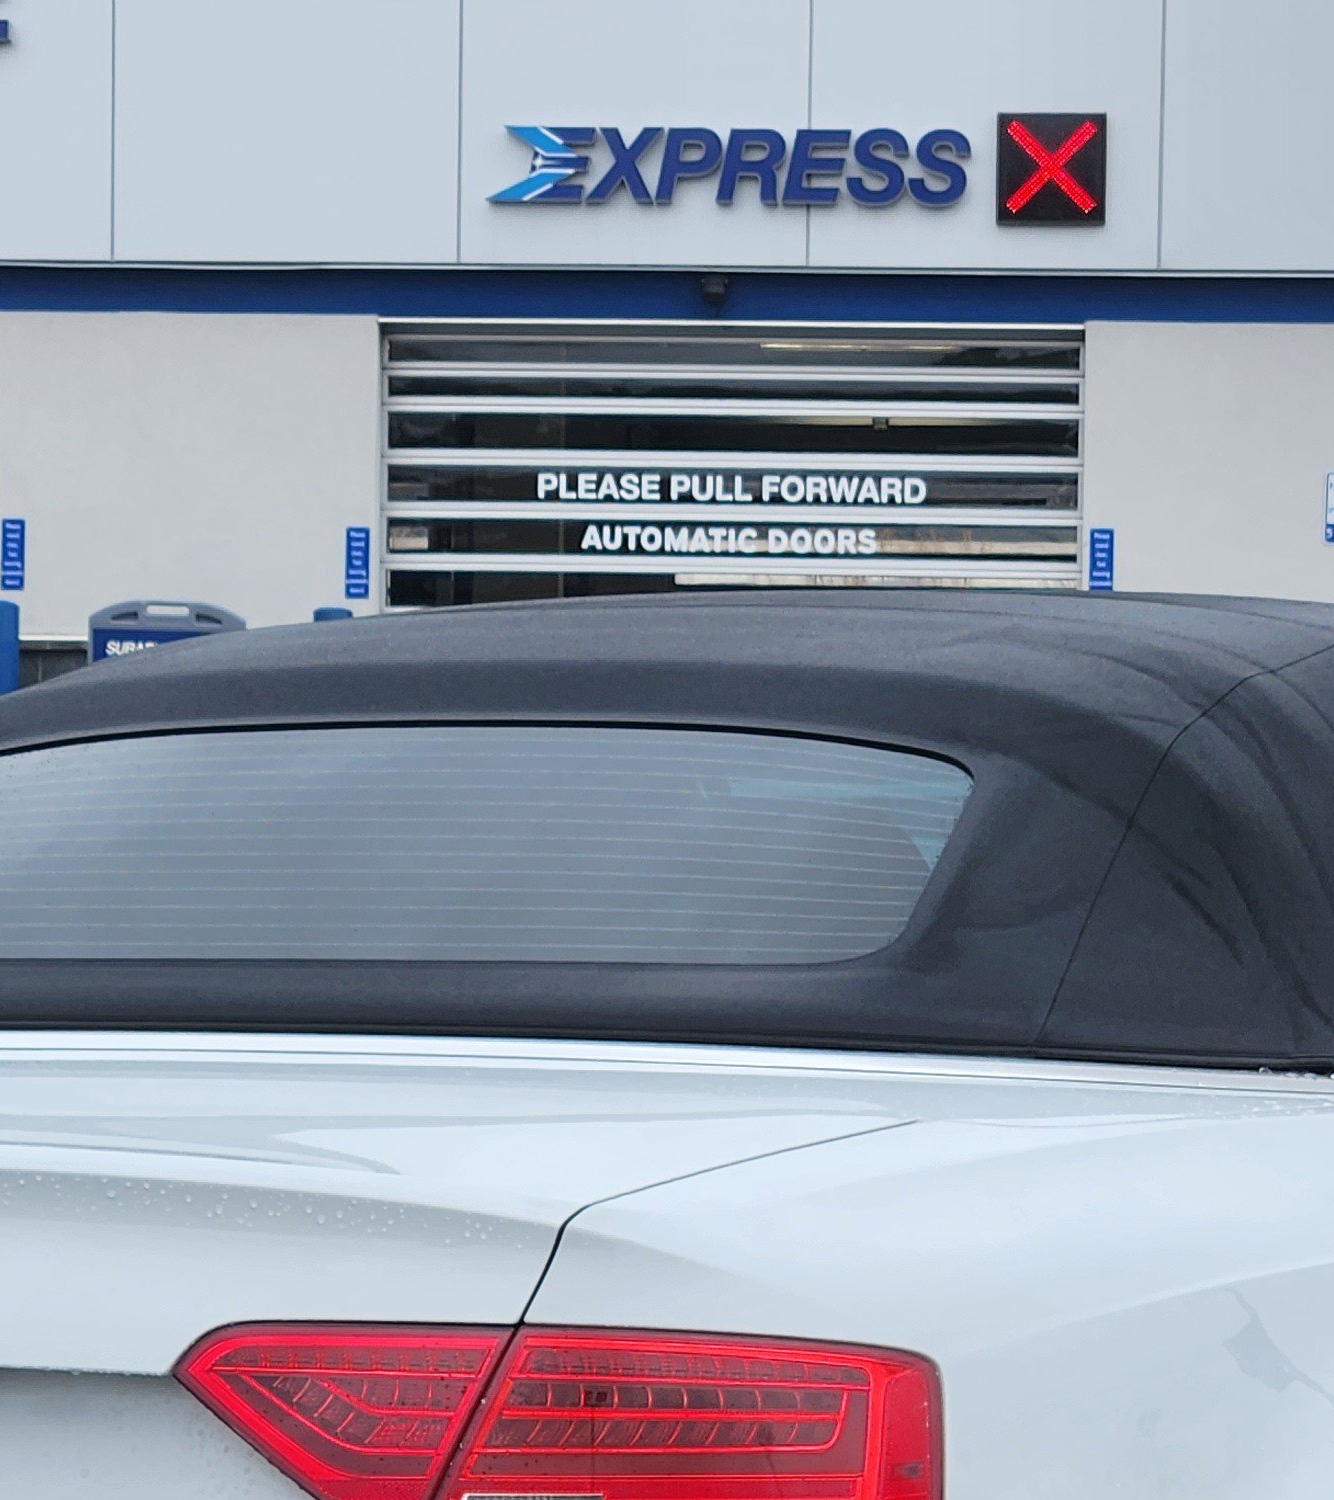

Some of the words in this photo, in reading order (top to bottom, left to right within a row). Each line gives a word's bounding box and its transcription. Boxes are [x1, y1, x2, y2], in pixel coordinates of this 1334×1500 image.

[485, 125, 971, 208] EXPRESS
[537, 472, 661, 500] PLEASE
[670, 473, 753, 502] PULL
[762, 474, 927, 504] FORWARD
[581, 524, 758, 554] AUTOMATIC
[768, 527, 878, 555] DOORS
